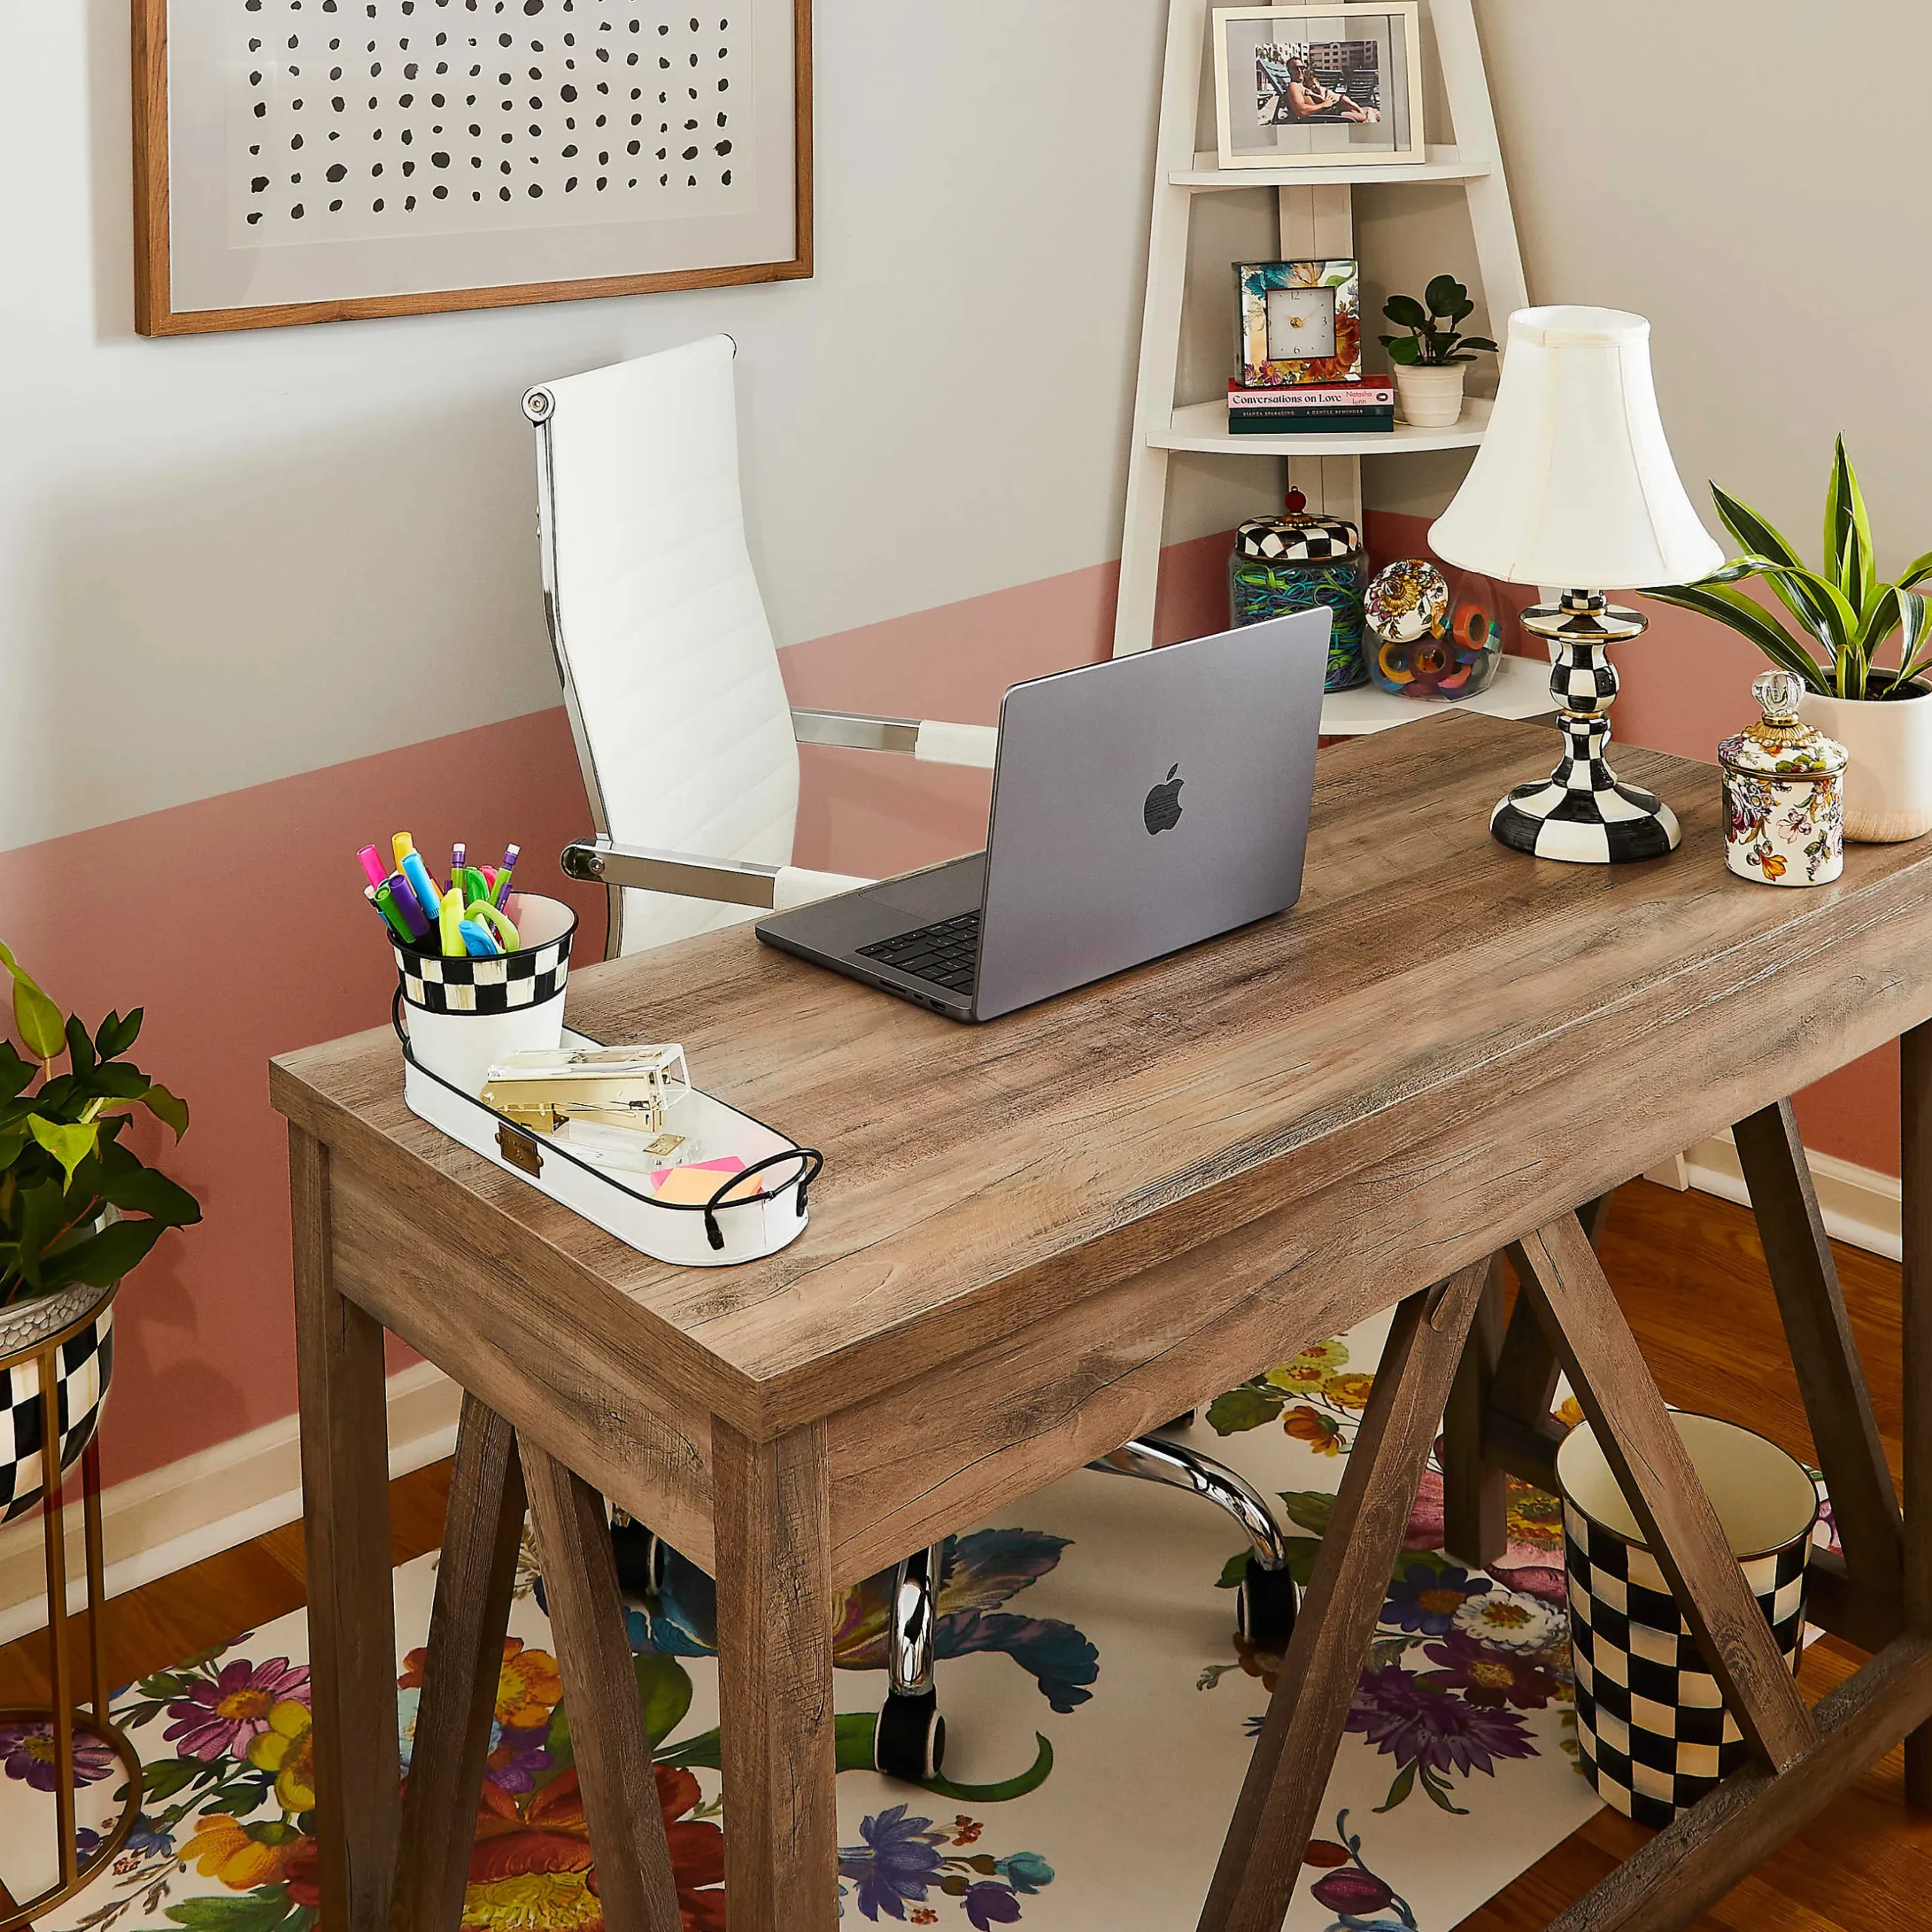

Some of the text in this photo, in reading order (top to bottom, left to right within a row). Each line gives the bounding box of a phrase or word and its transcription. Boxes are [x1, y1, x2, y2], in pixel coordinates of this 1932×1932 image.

[1291, 291, 1300, 300] 12
[1321, 316, 1327, 326] 3
[1294, 345, 1300, 355] 6
[1232, 395, 1302, 404] Conversations
[1318, 394, 1342, 402] Love
